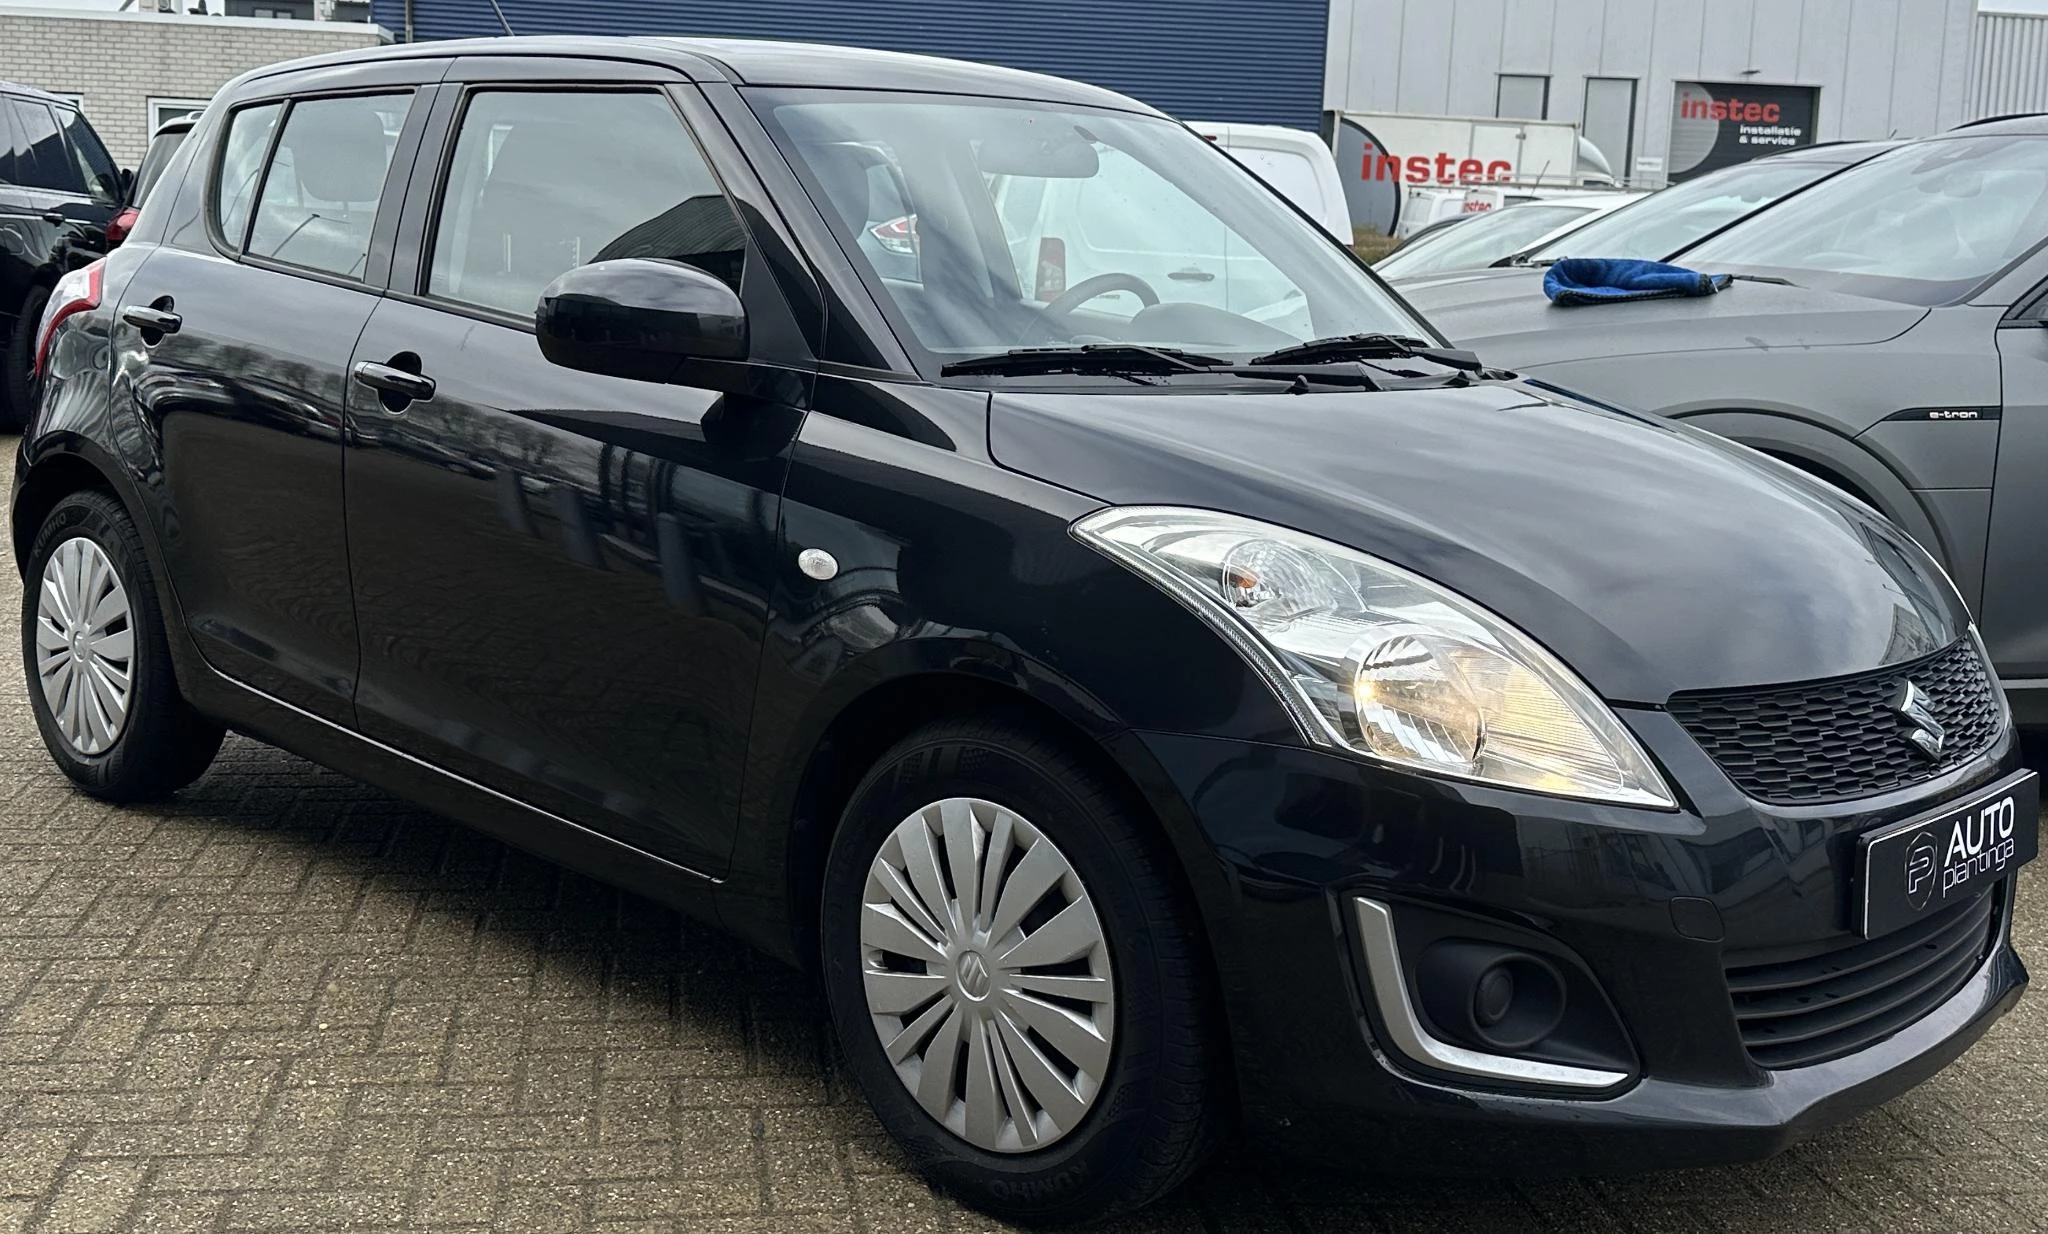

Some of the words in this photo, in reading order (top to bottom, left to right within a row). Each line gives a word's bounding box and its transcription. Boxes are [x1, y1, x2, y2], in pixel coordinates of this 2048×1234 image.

[1681, 92, 1780, 123] instec
[1739, 135, 1747, 144] &
[1751, 136, 1796, 146] service
[1740, 124, 1801, 136] installatie
[1361, 143, 1511, 184] instec
[1944, 796, 2014, 867] AUTO
[1943, 838, 2014, 898] plantinga
